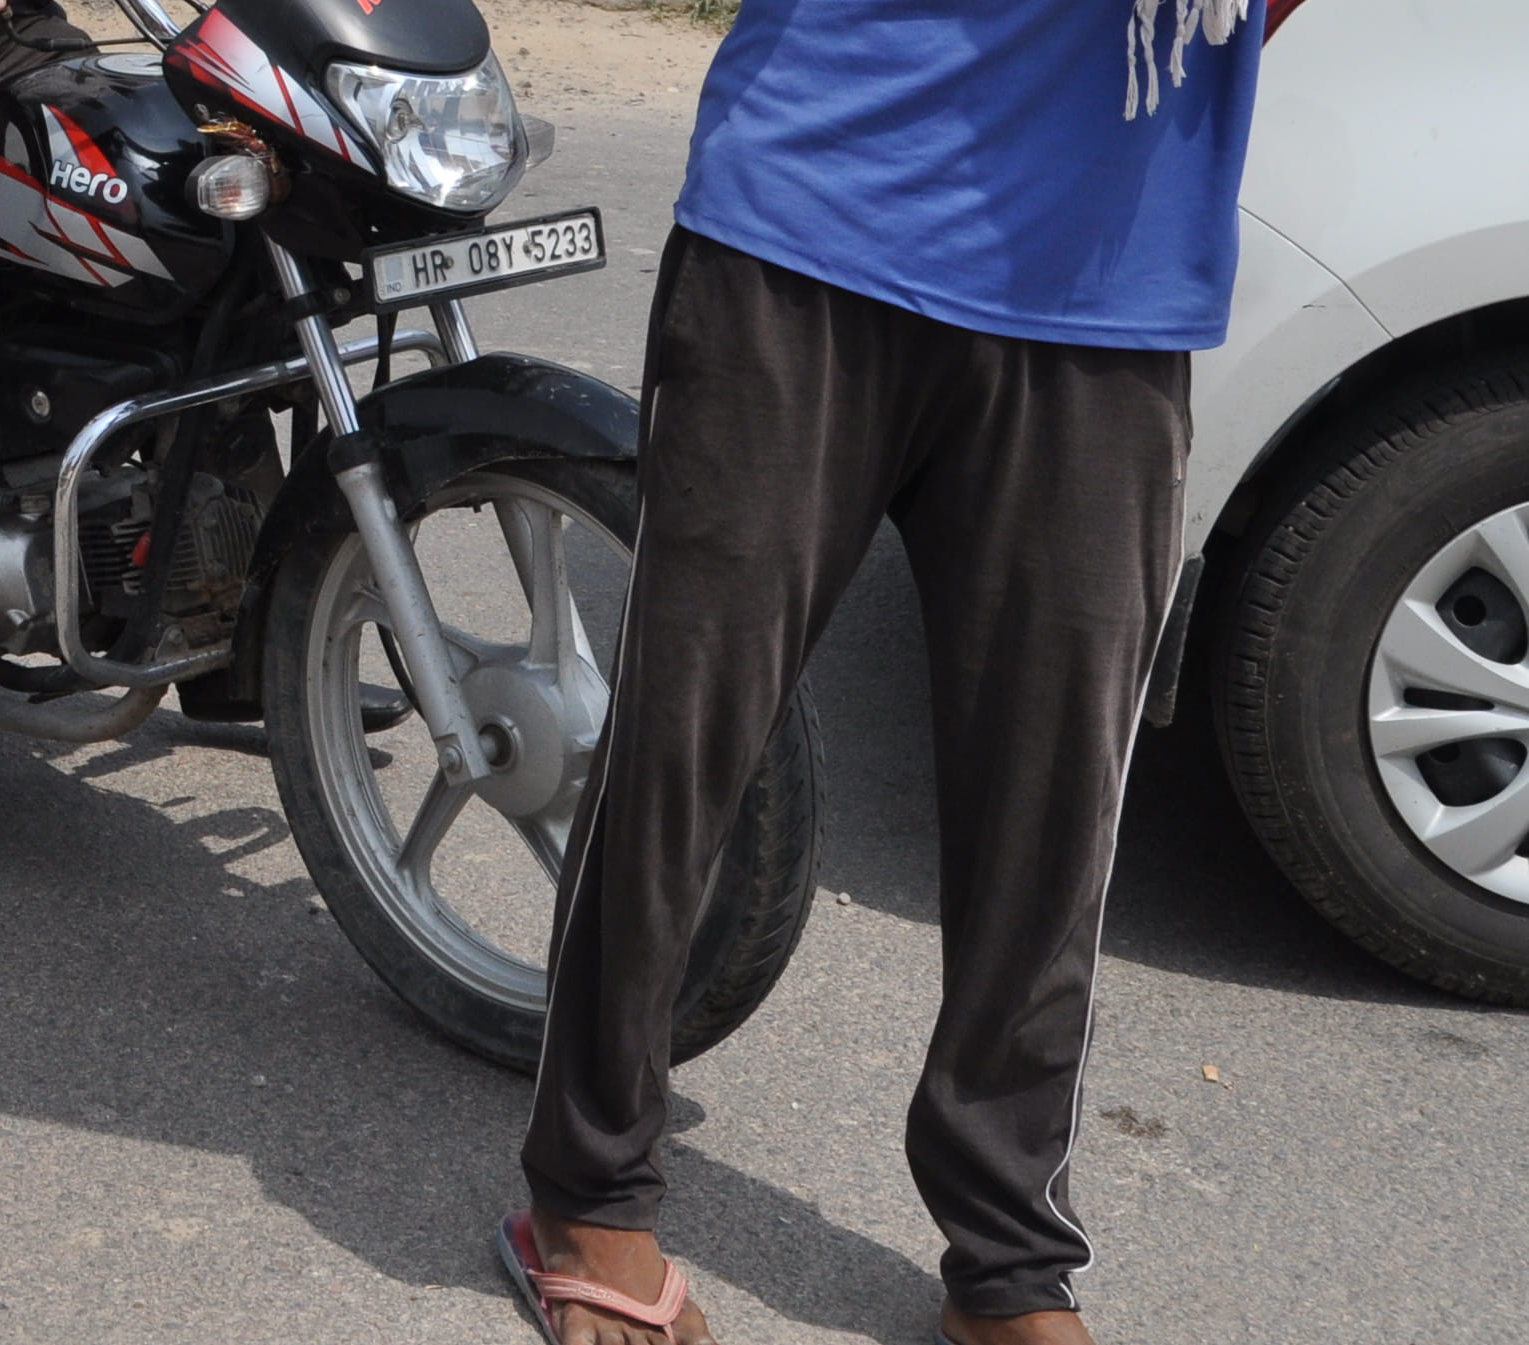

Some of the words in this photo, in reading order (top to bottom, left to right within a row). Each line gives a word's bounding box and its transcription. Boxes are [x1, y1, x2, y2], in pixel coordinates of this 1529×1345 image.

[50, 160, 128, 204] Hero
[412, 250, 447, 288] HR
[468, 236, 514, 275] 08Y
[530, 222, 593, 263] 5233
